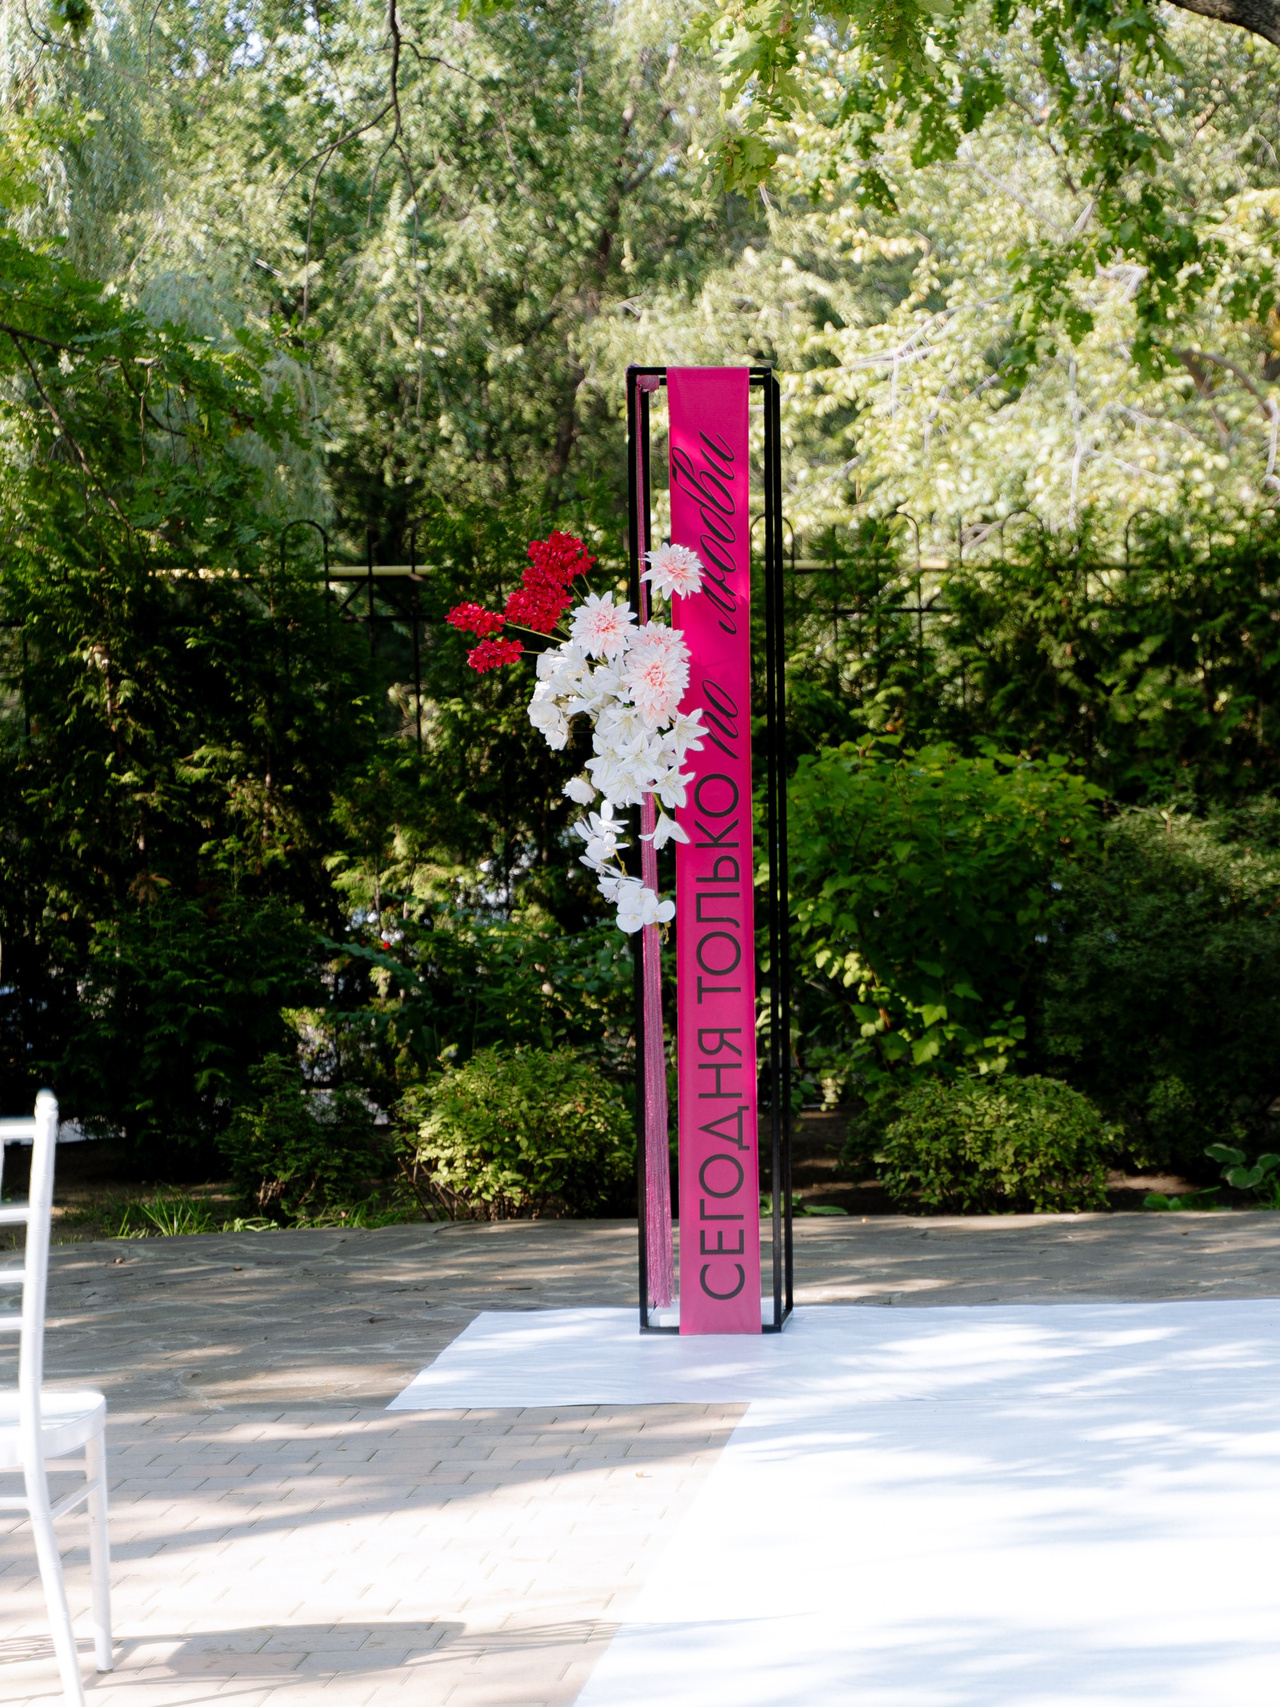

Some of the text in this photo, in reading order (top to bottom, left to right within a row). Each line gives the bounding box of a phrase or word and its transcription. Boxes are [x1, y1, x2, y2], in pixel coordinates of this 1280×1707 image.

[671, 430, 750, 1301] СЕГОДНЯ ТОЛЬКО по любви
